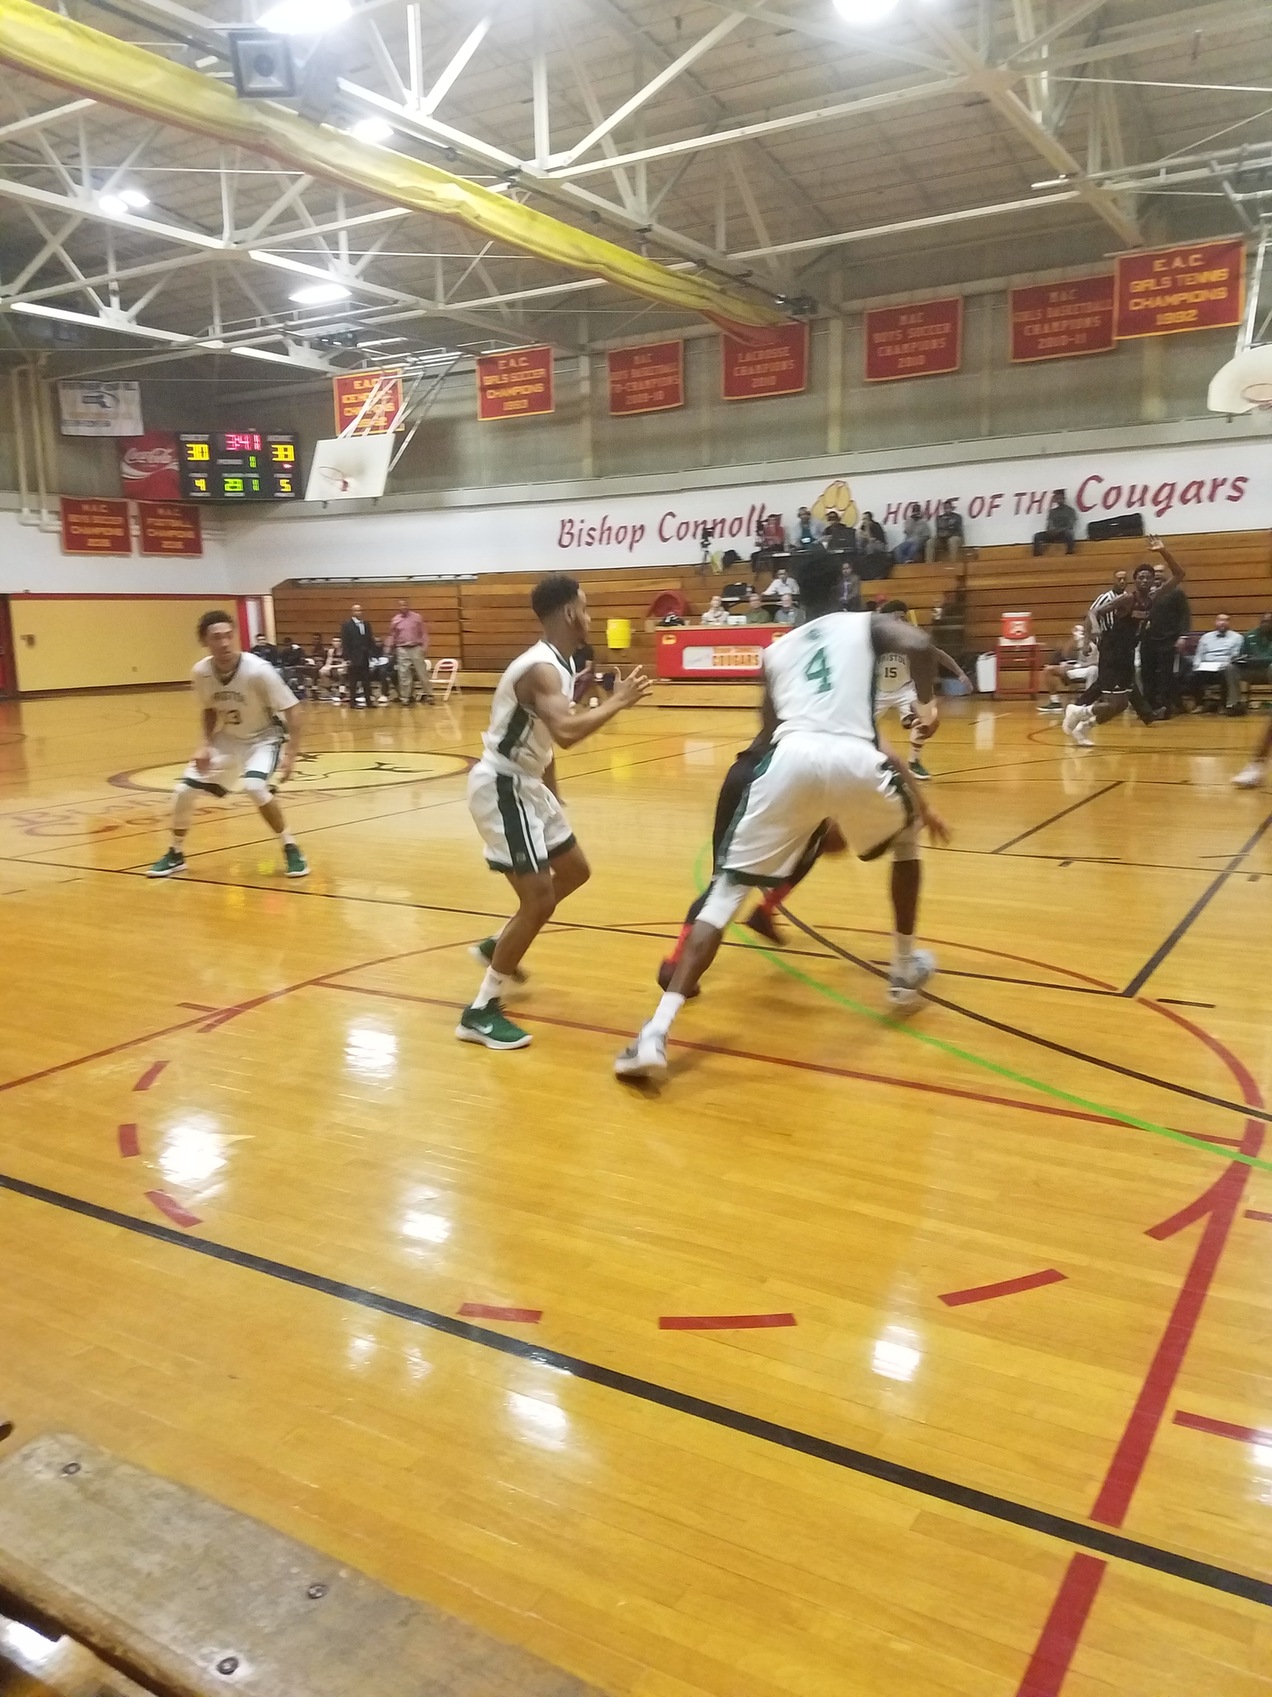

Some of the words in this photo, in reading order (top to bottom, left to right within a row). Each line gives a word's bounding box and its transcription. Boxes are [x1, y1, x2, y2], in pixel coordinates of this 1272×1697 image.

[1176, 268, 1229, 286] TENNIS
[1128, 287, 1228, 311] CHAMPIONS
[485, 383, 545, 399] CHAMPIONS
[279, 479, 292, 491] 5
[968, 492, 1005, 519] OF
[1076, 474, 1250, 518] Cougars
[557, 514, 645, 552] Bishop
[658, 503, 780, 544] Connoll
[804, 645, 833, 695] 4
[884, 667, 898, 679] 15
